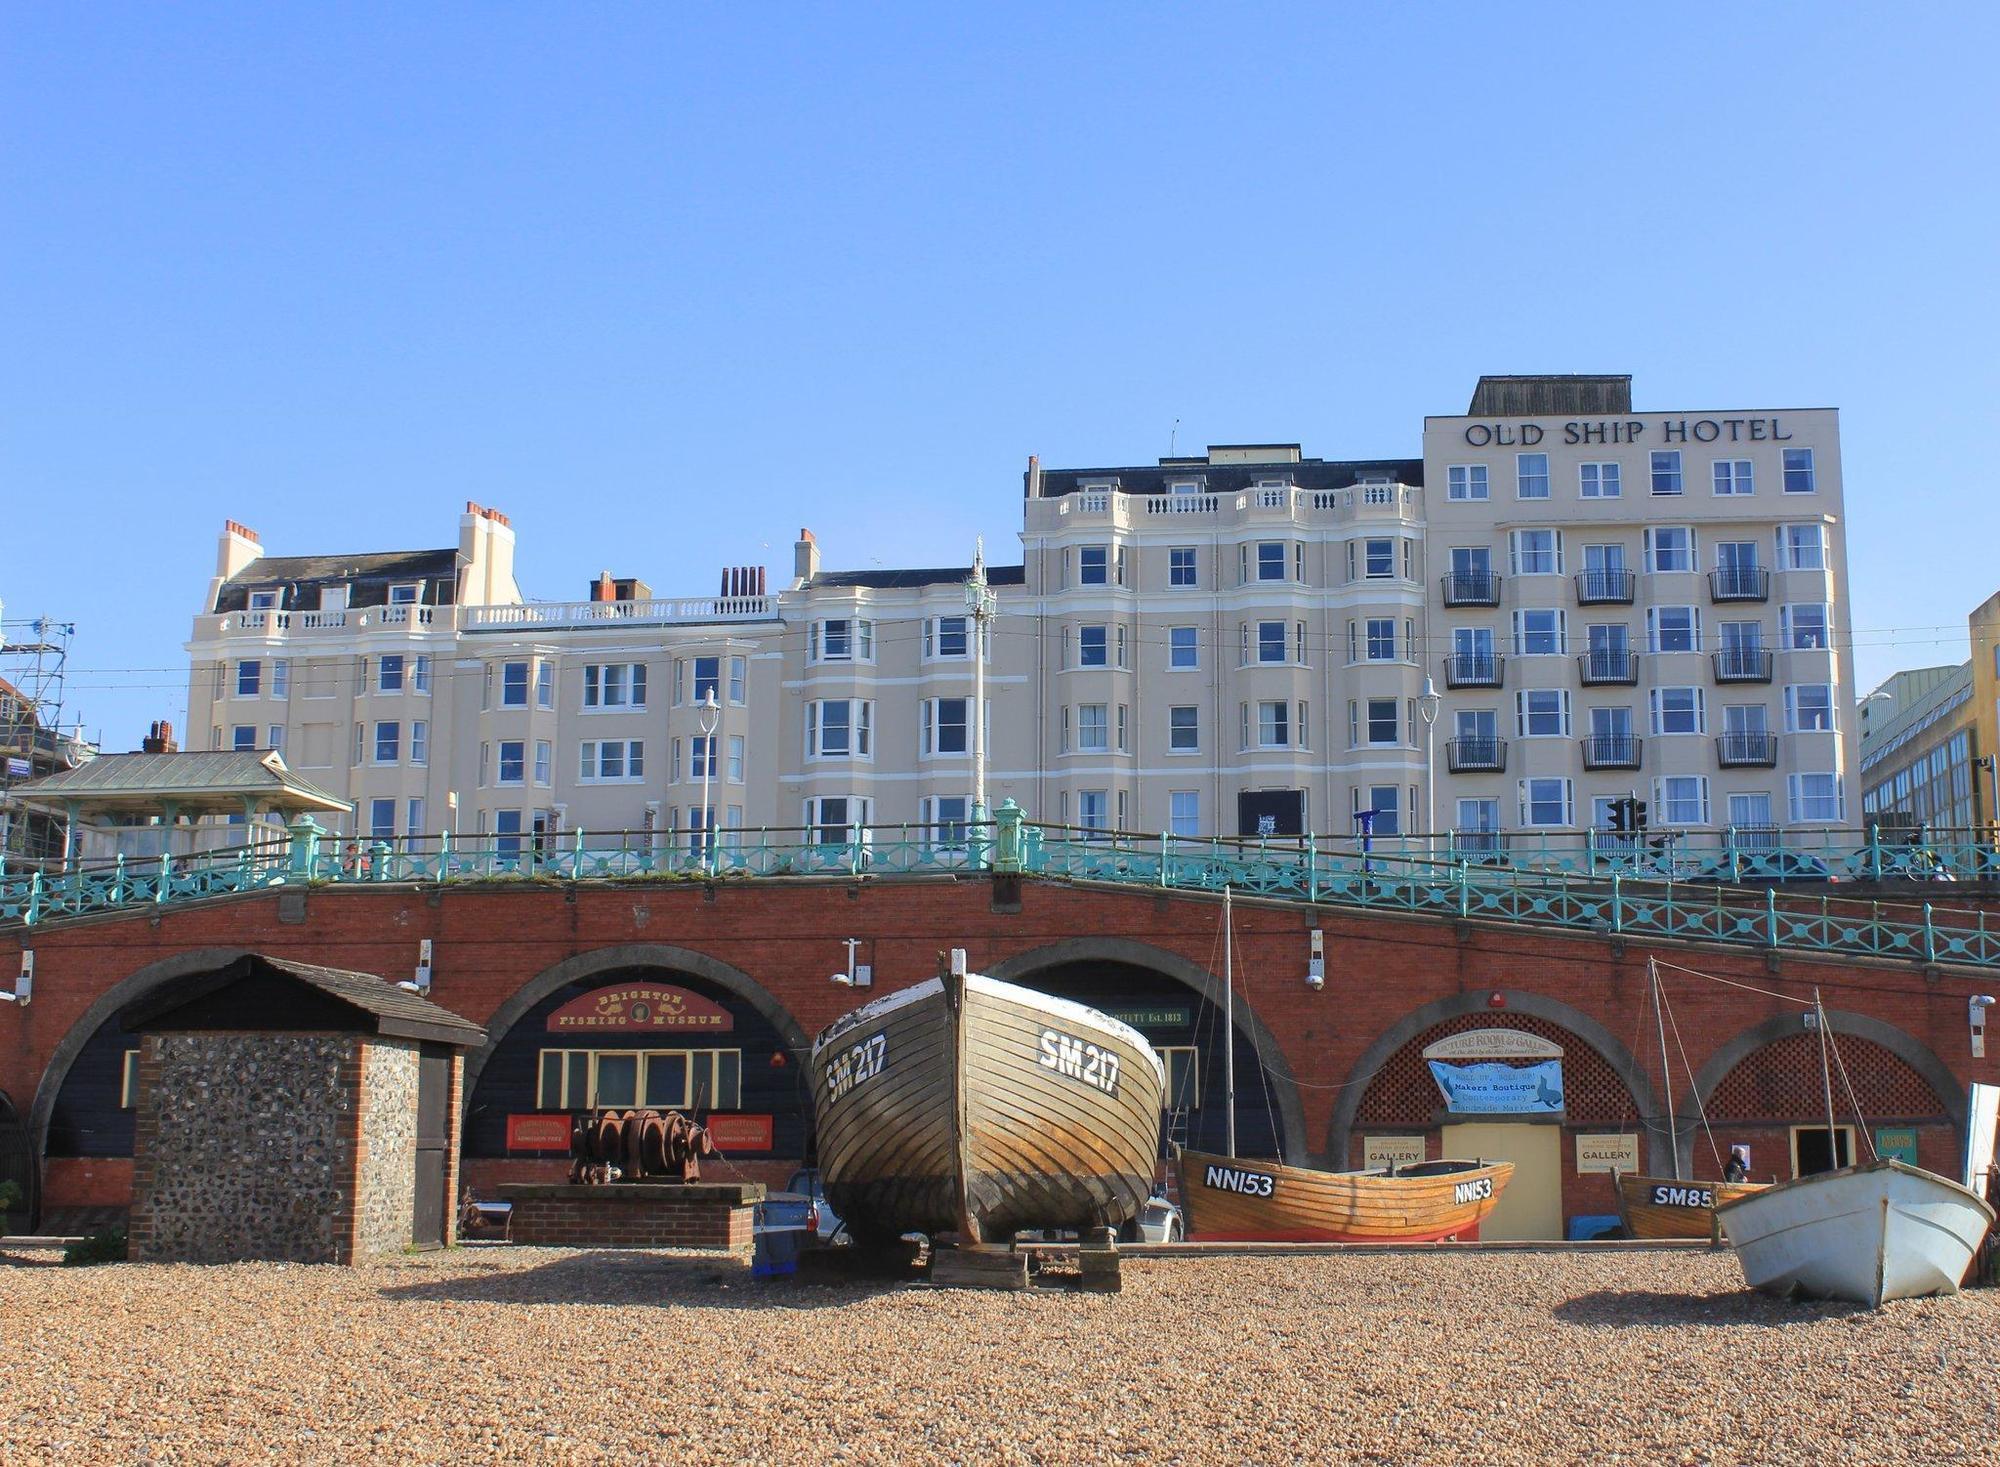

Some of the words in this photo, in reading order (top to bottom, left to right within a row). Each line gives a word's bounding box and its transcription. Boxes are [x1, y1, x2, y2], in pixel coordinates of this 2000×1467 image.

[1465, 424, 1544, 446] OLD
[1564, 421, 1644, 445] SHIP
[1663, 419, 1793, 443] HOTEL
[599, 990, 683, 1005] BRIGHTON
[559, 1016, 627, 1025] FISHING
[652, 1015, 722, 1025] MUSEUM
[1164, 1013, 1182, 1022] 1813
[1493, 1084, 1536, 1092] Boutique
[1582, 1151, 1632, 1160] GALLERY
[1206, 1166, 1273, 1197] NN153
[1455, 1179, 1492, 1205] NN153
[1655, 1187, 1713, 1208] SM85
